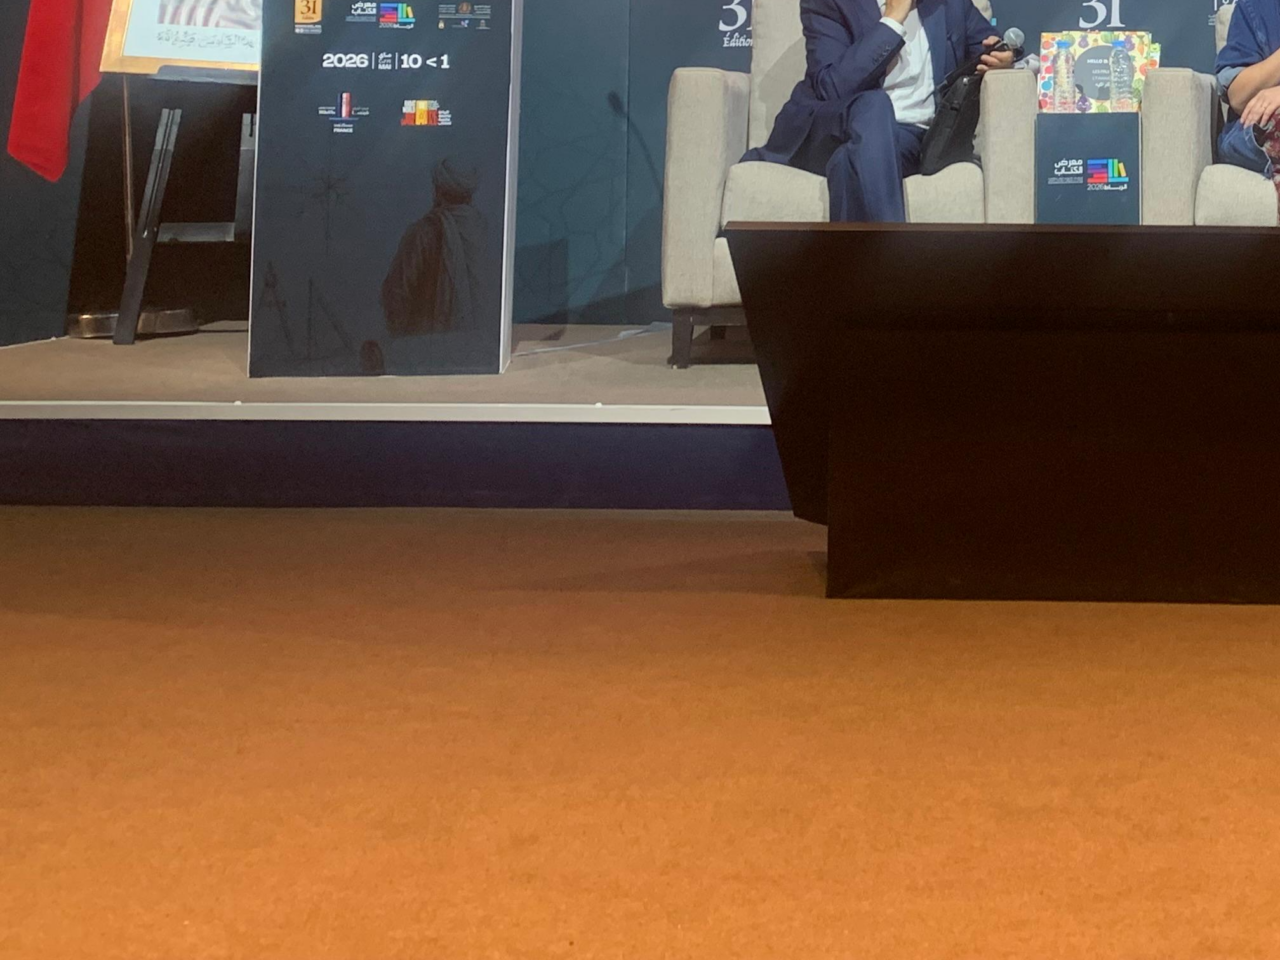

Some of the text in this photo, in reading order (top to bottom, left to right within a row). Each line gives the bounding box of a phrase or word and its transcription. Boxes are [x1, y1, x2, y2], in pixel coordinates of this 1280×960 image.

[300, 0, 317, 15] 31
[723, 32, 753, 48] Éditio
[322, 53, 450, 69] 2026 10 1
